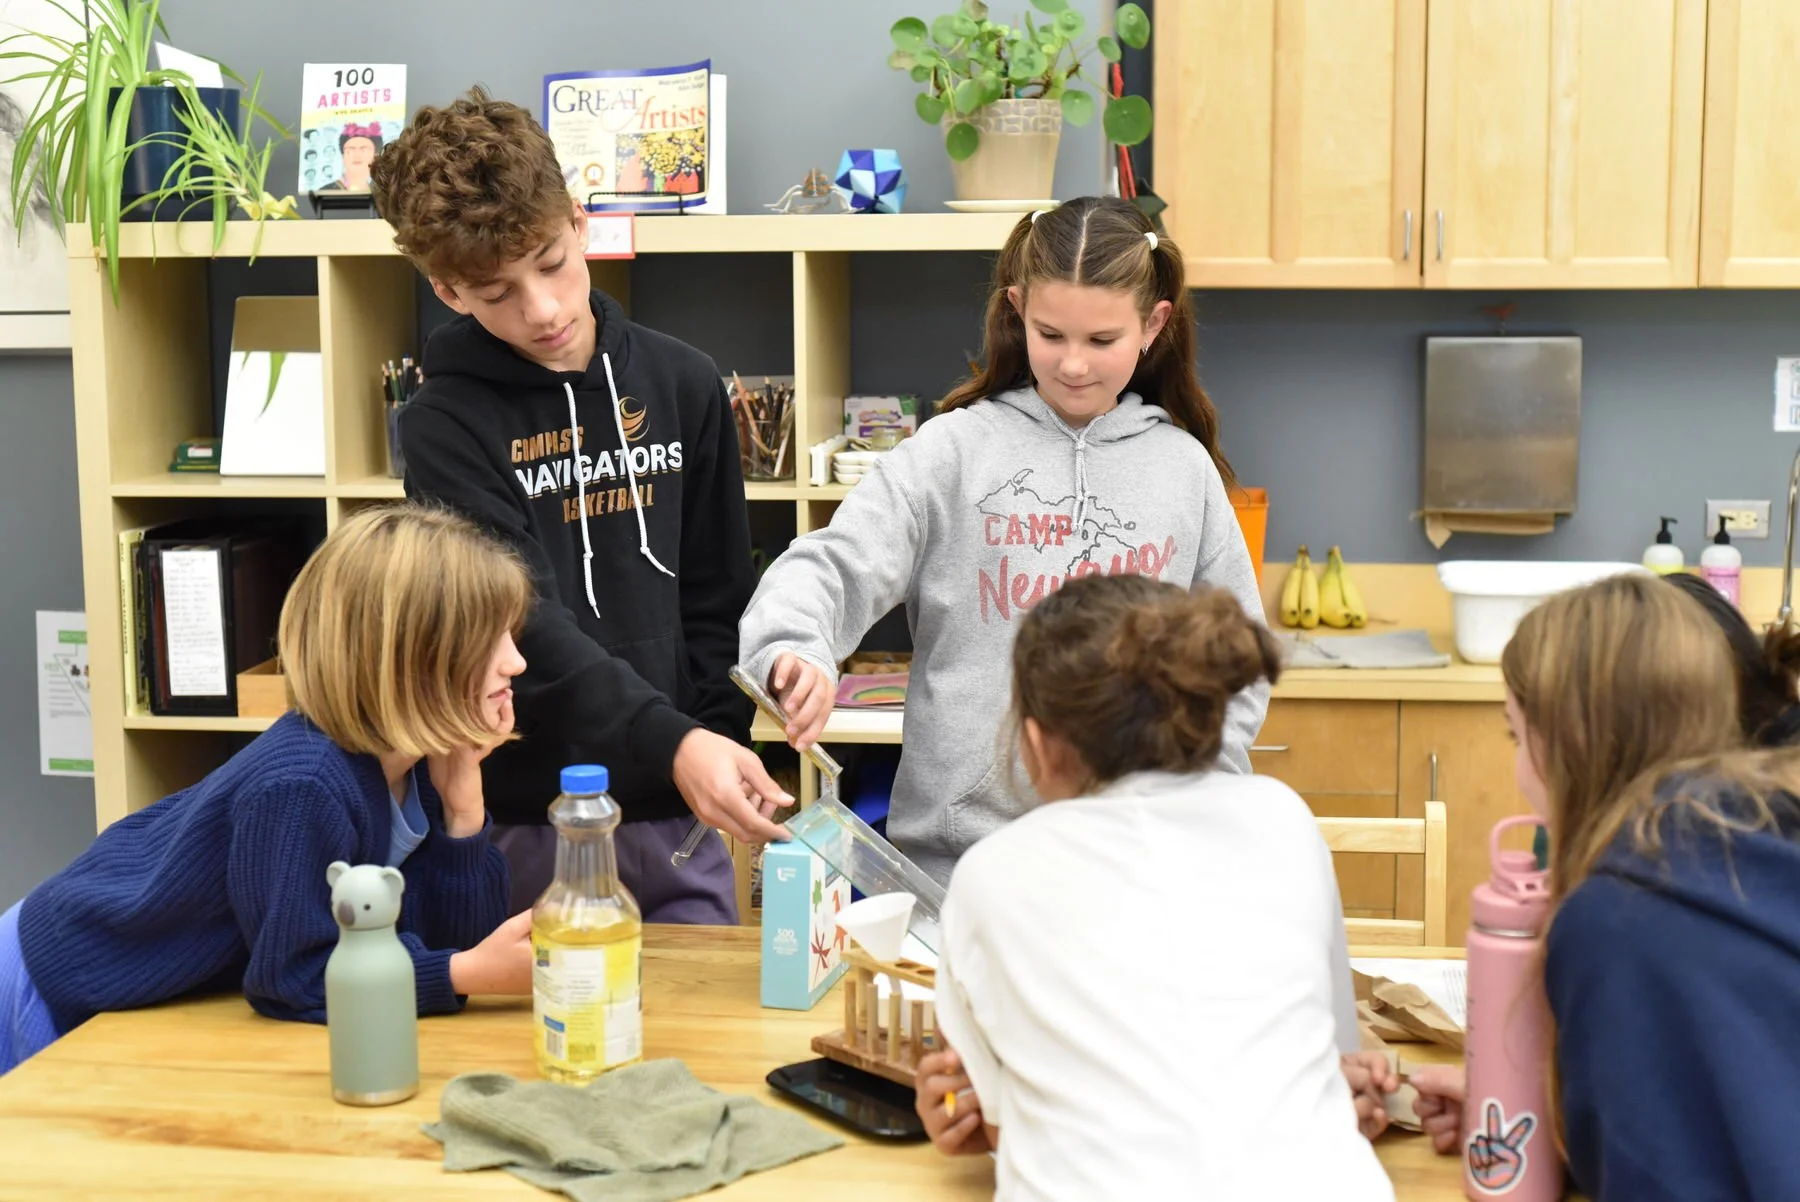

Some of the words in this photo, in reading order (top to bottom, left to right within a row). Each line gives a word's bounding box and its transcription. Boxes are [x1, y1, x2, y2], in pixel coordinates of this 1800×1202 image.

[334, 67, 375, 88] 100
[317, 88, 392, 109] ARTISTS
[601, 95, 706, 133] Artists
[514, 441, 684, 499] NAVIGATORS
[984, 513, 1073, 546] CAMP
